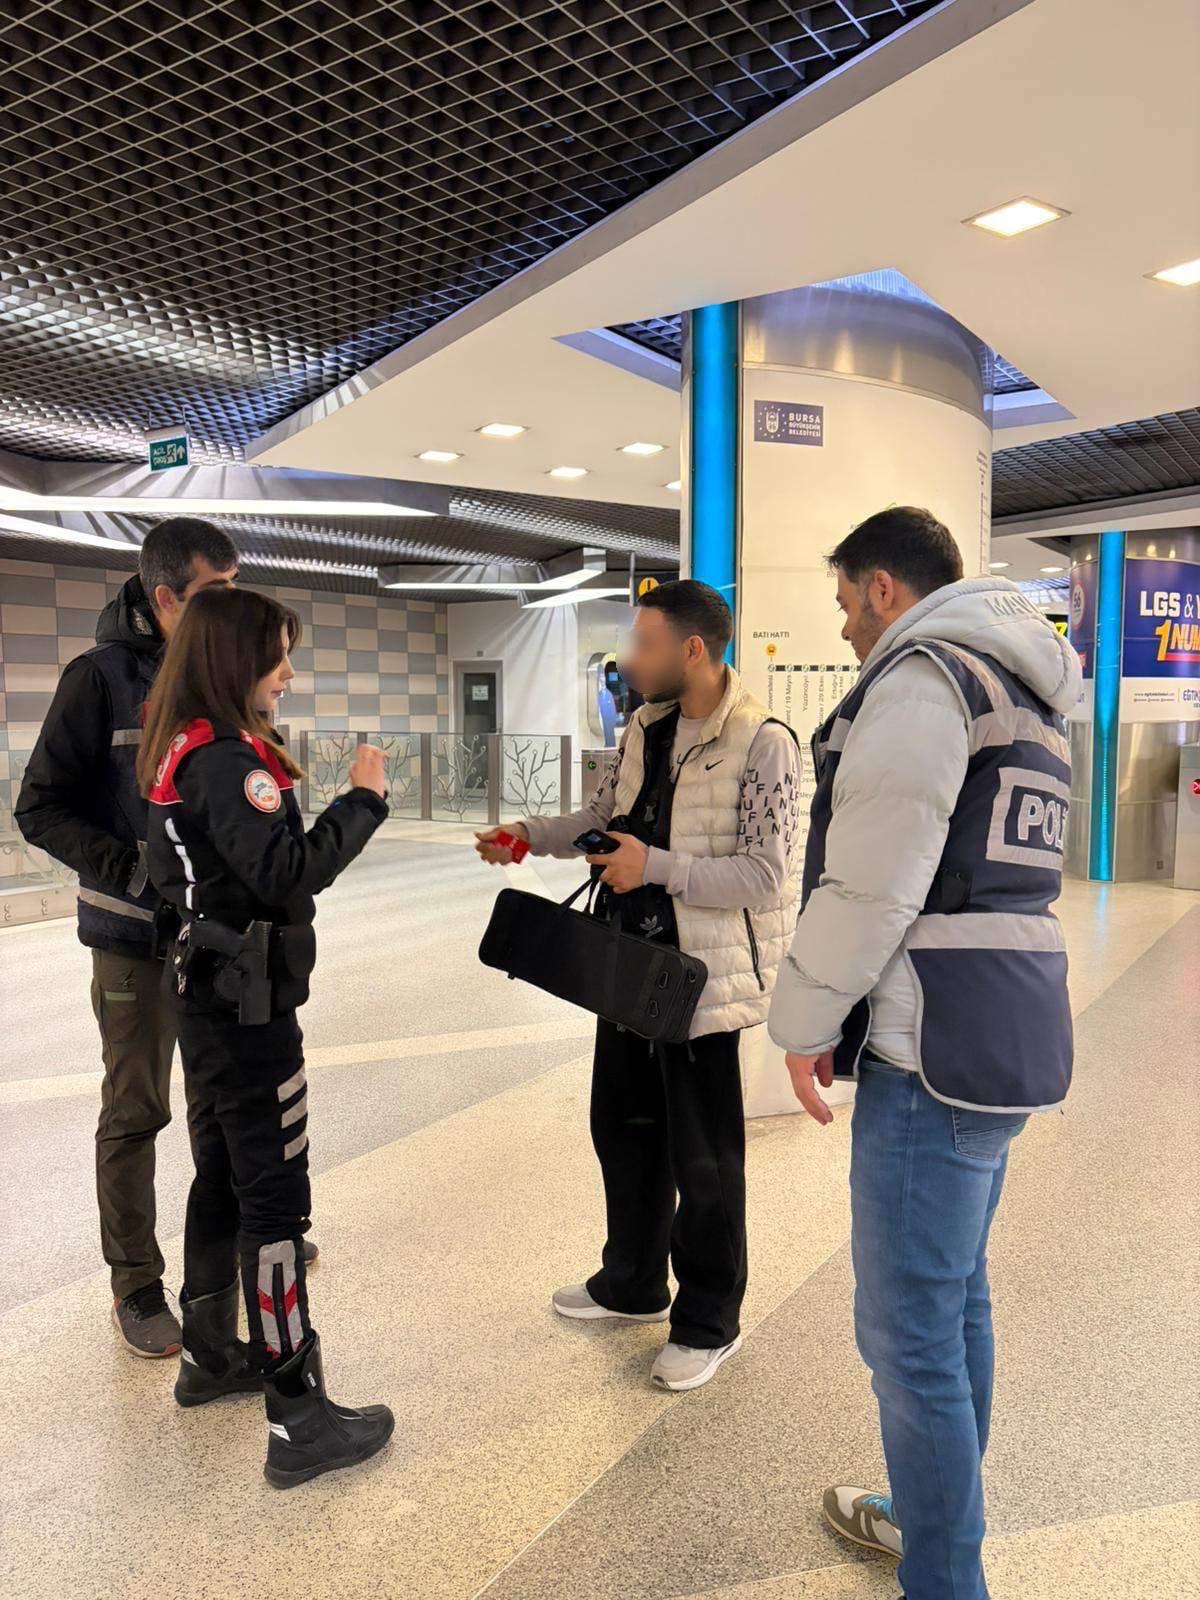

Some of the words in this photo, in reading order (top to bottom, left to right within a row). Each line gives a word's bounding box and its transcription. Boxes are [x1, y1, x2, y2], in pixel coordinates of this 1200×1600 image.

[789, 412, 820, 424] BURSA
[1140, 591, 1180, 617] LGS
[1184, 593, 1193, 619] &
[753, 631, 769, 639] BATI
[770, 631, 790, 639] HATTI
